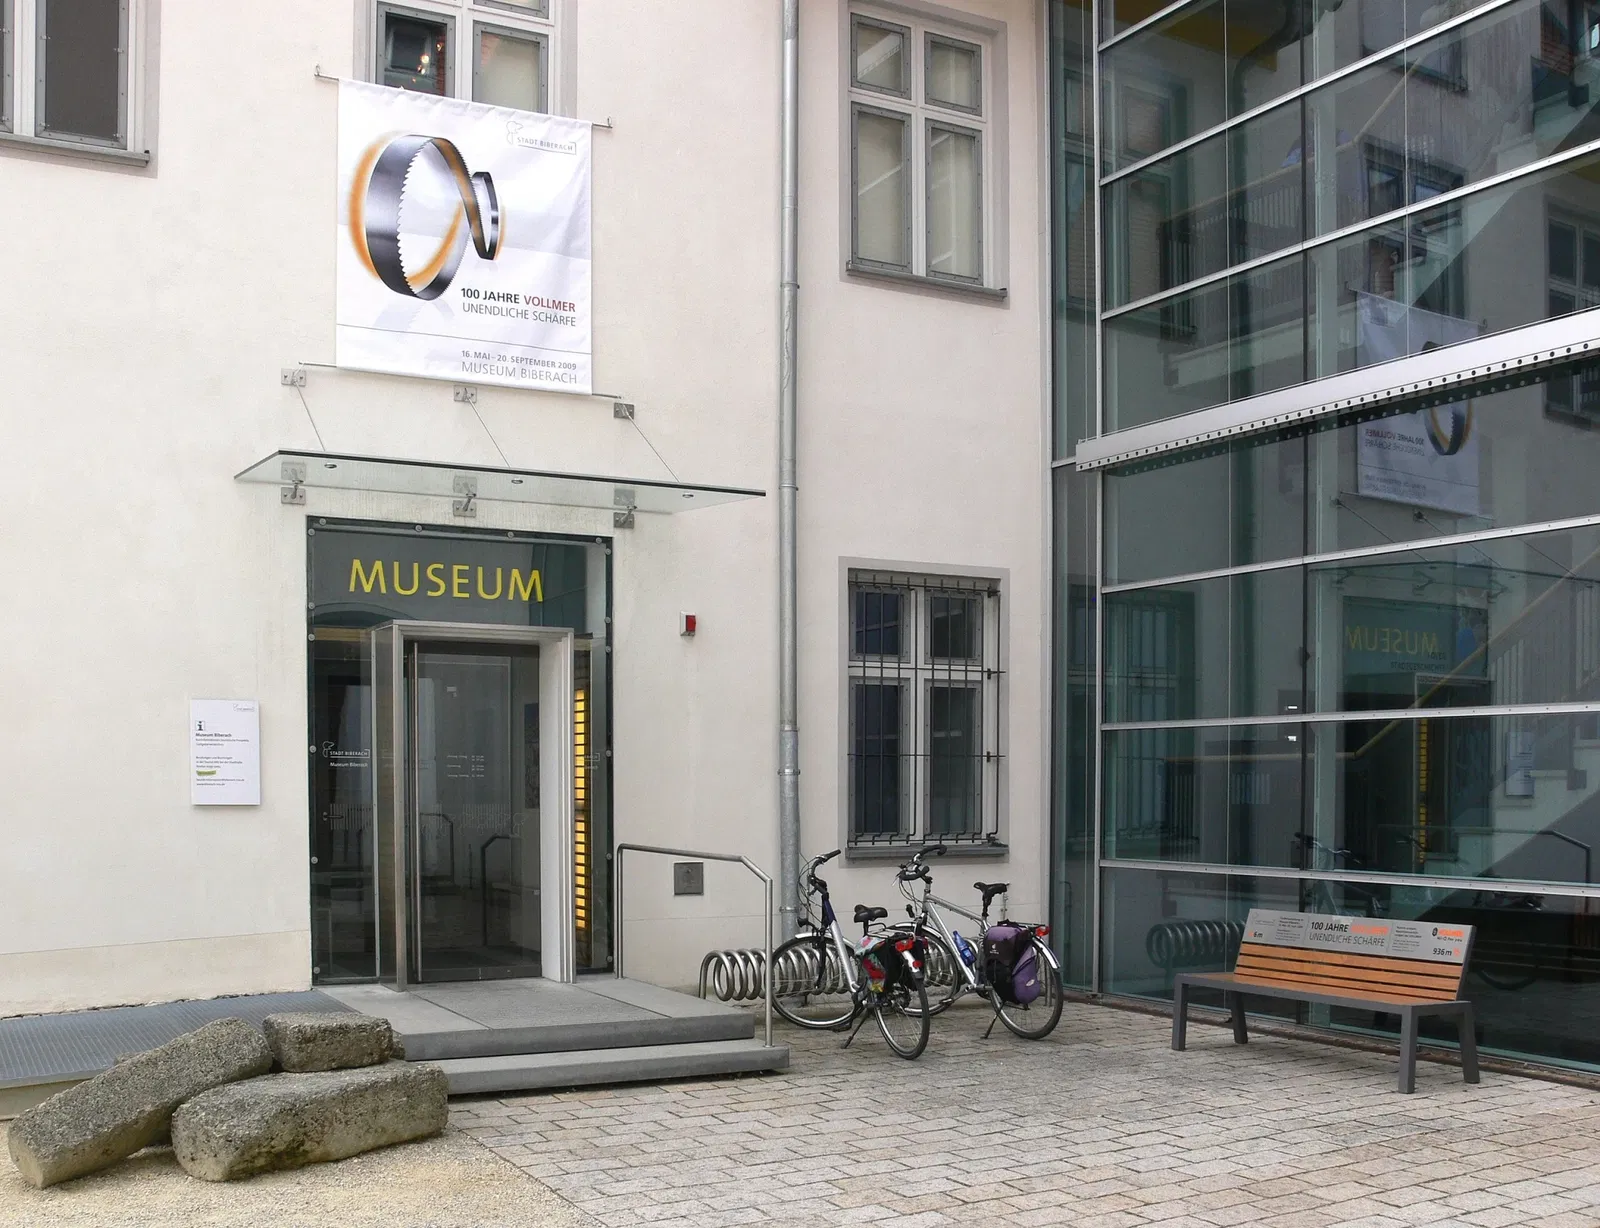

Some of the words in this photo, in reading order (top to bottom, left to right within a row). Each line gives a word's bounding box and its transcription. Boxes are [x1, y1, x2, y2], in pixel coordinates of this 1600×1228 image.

[517, 136, 538, 145] STADT
[540, 140, 573, 151] BIBERACH
[461, 287, 480, 299] 100
[483, 291, 520, 304] JAHRE
[524, 295, 576, 313] VOLLMER
[462, 302, 529, 320] UNENDLICHE
[532, 310, 576, 327] SCHÄRFE
[461, 361, 516, 377] MUSEUM
[520, 368, 577, 384] BIBERACH
[511, 356, 556, 369] SEPTEMBER
[558, 361, 577, 371] 2009
[349, 558, 544, 603] MUSEUM
[1311, 921, 1324, 930] 100
[1324, 922, 1349, 933] JAHRE
[1309, 932, 1352, 944] UNENDLICHE
[1353, 935, 1385, 947] SCHÄRFE
